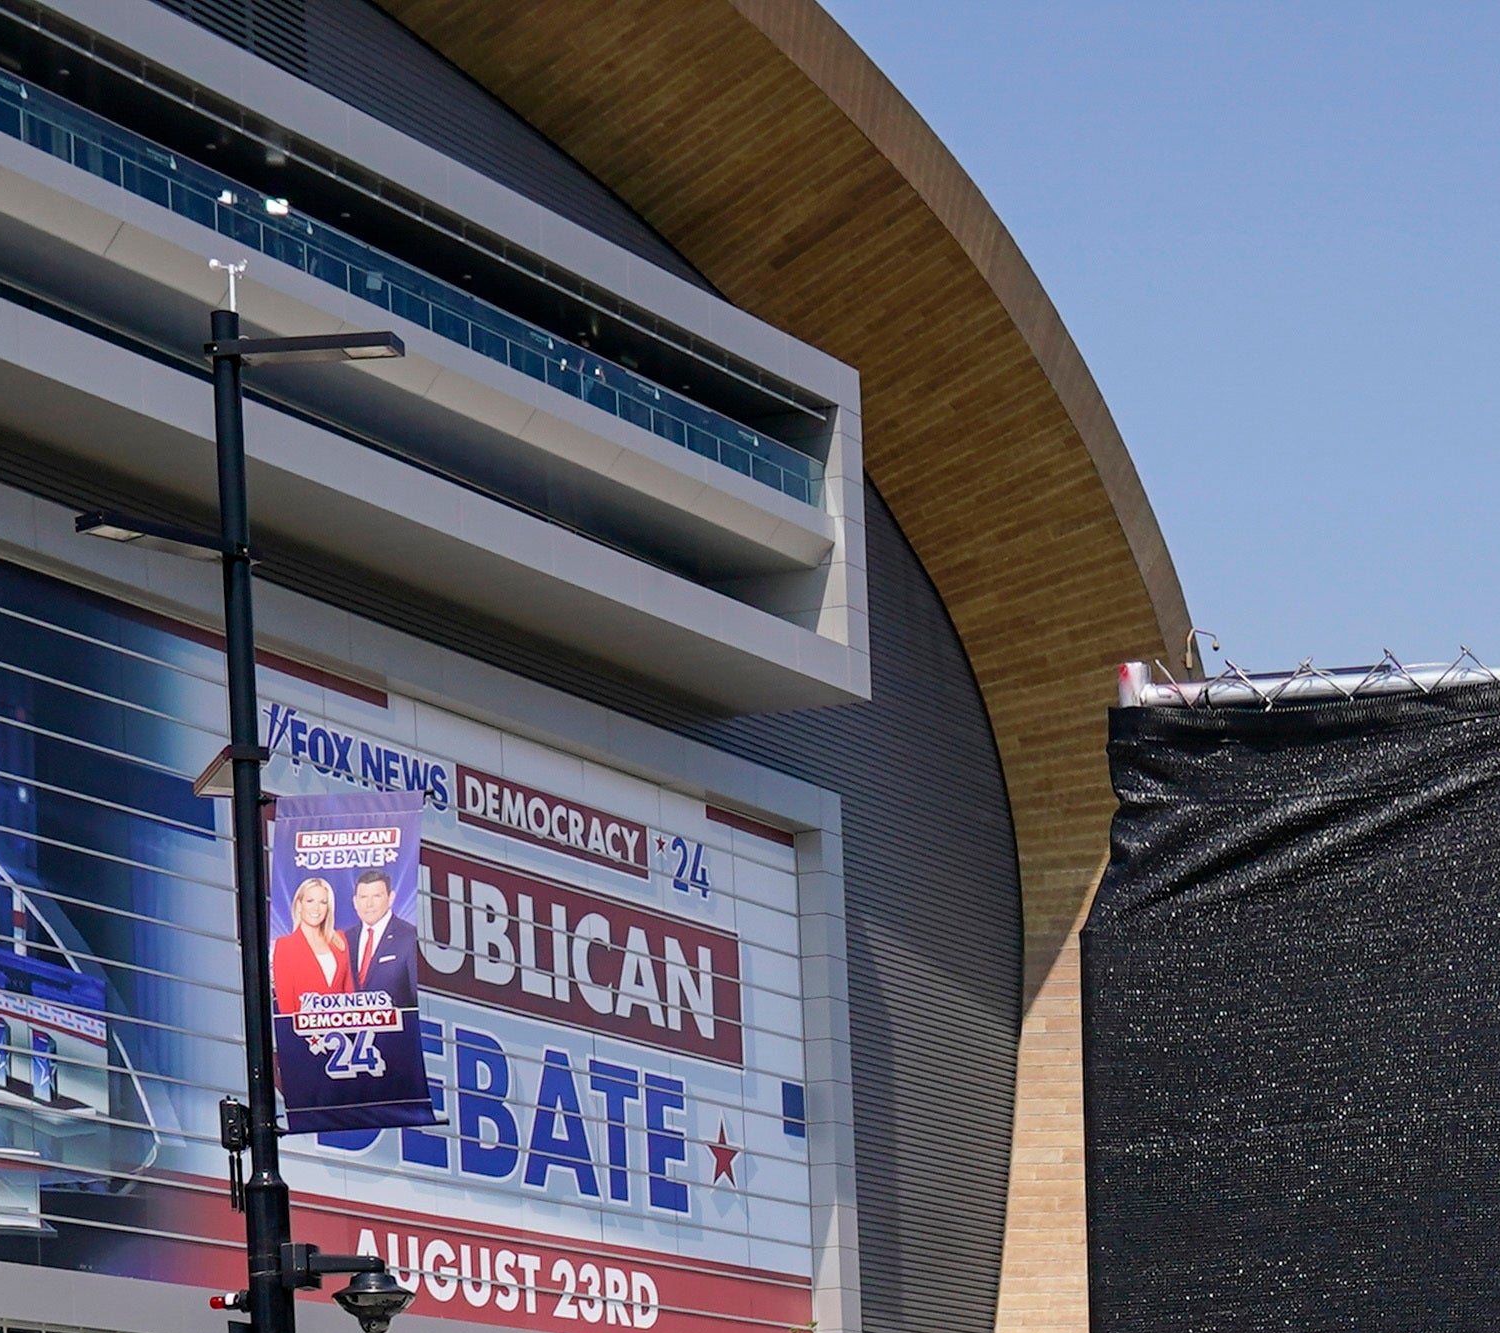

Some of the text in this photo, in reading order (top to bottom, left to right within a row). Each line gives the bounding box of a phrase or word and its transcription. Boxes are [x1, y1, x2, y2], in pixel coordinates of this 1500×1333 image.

[291, 720, 450, 813] FOX NEWS
[302, 830, 392, 847] REPUBLICAN
[464, 774, 640, 864] DEMOCRACY
[308, 848, 383, 866] DEBATE
[671, 835, 711, 900] 24
[418, 864, 715, 1041] UBLICAN
[298, 1010, 393, 1028] DEMOCRACY
[313, 992, 387, 1008] FOX NEWS
[324, 1031, 378, 1073] 24
[316, 1018, 690, 1215] EBATE
[356, 1228, 659, 1330] AUGUST 23RD
